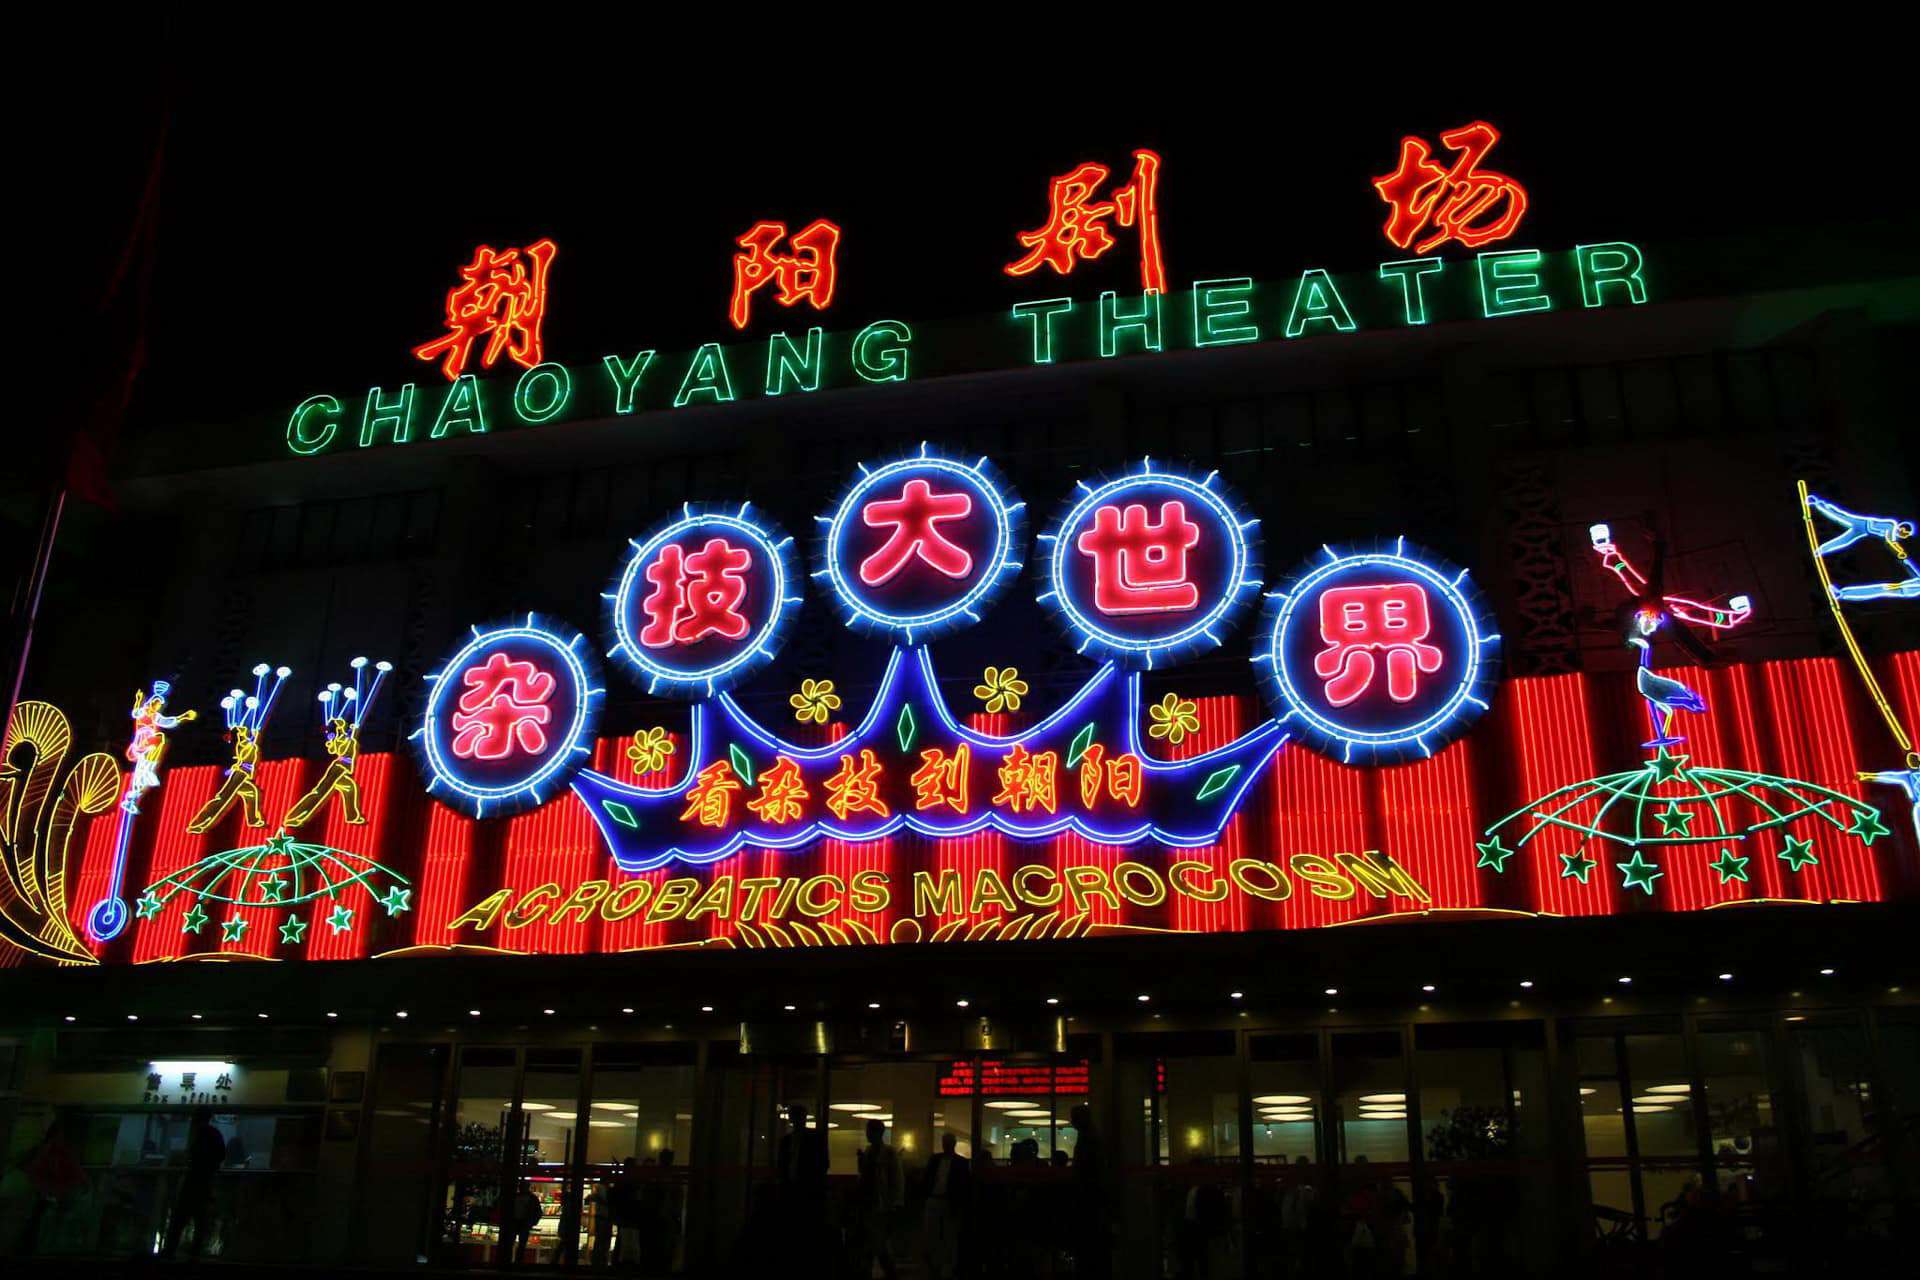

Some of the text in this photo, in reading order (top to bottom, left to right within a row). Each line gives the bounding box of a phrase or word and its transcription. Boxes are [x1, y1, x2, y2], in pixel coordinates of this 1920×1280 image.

[286, 240, 1648, 455] CHAOYANG THEATER
[412, 121, 1527, 381] 朝阳剧场
[452, 479, 1443, 761] 杂技大世界
[447, 850, 1432, 931] ACROBATICS MACROCOSM
[680, 742, 1143, 827] 看杂技到朝阳
